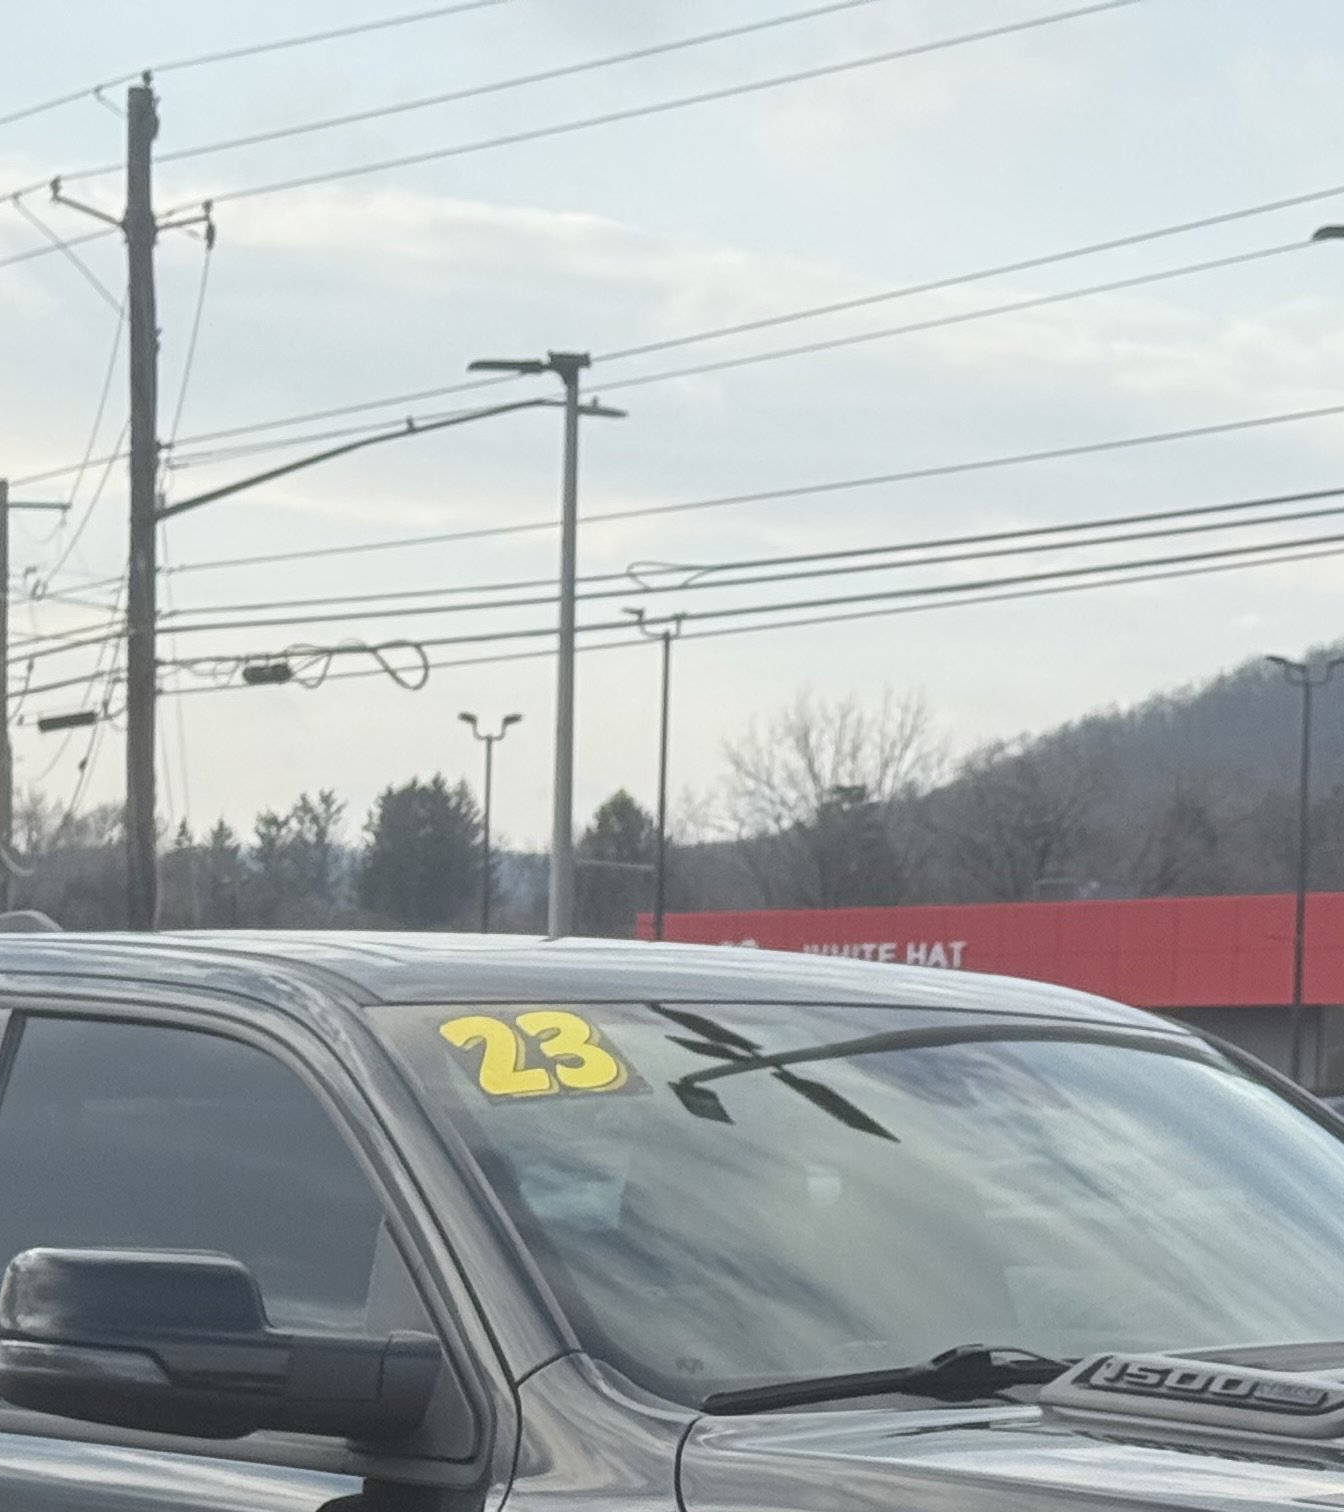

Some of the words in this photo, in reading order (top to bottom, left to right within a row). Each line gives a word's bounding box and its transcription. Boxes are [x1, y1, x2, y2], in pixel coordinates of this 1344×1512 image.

[906, 941, 968, 969] HAT
[438, 1010, 625, 1097] 23
[1089, 1359, 1255, 1396] 1500
